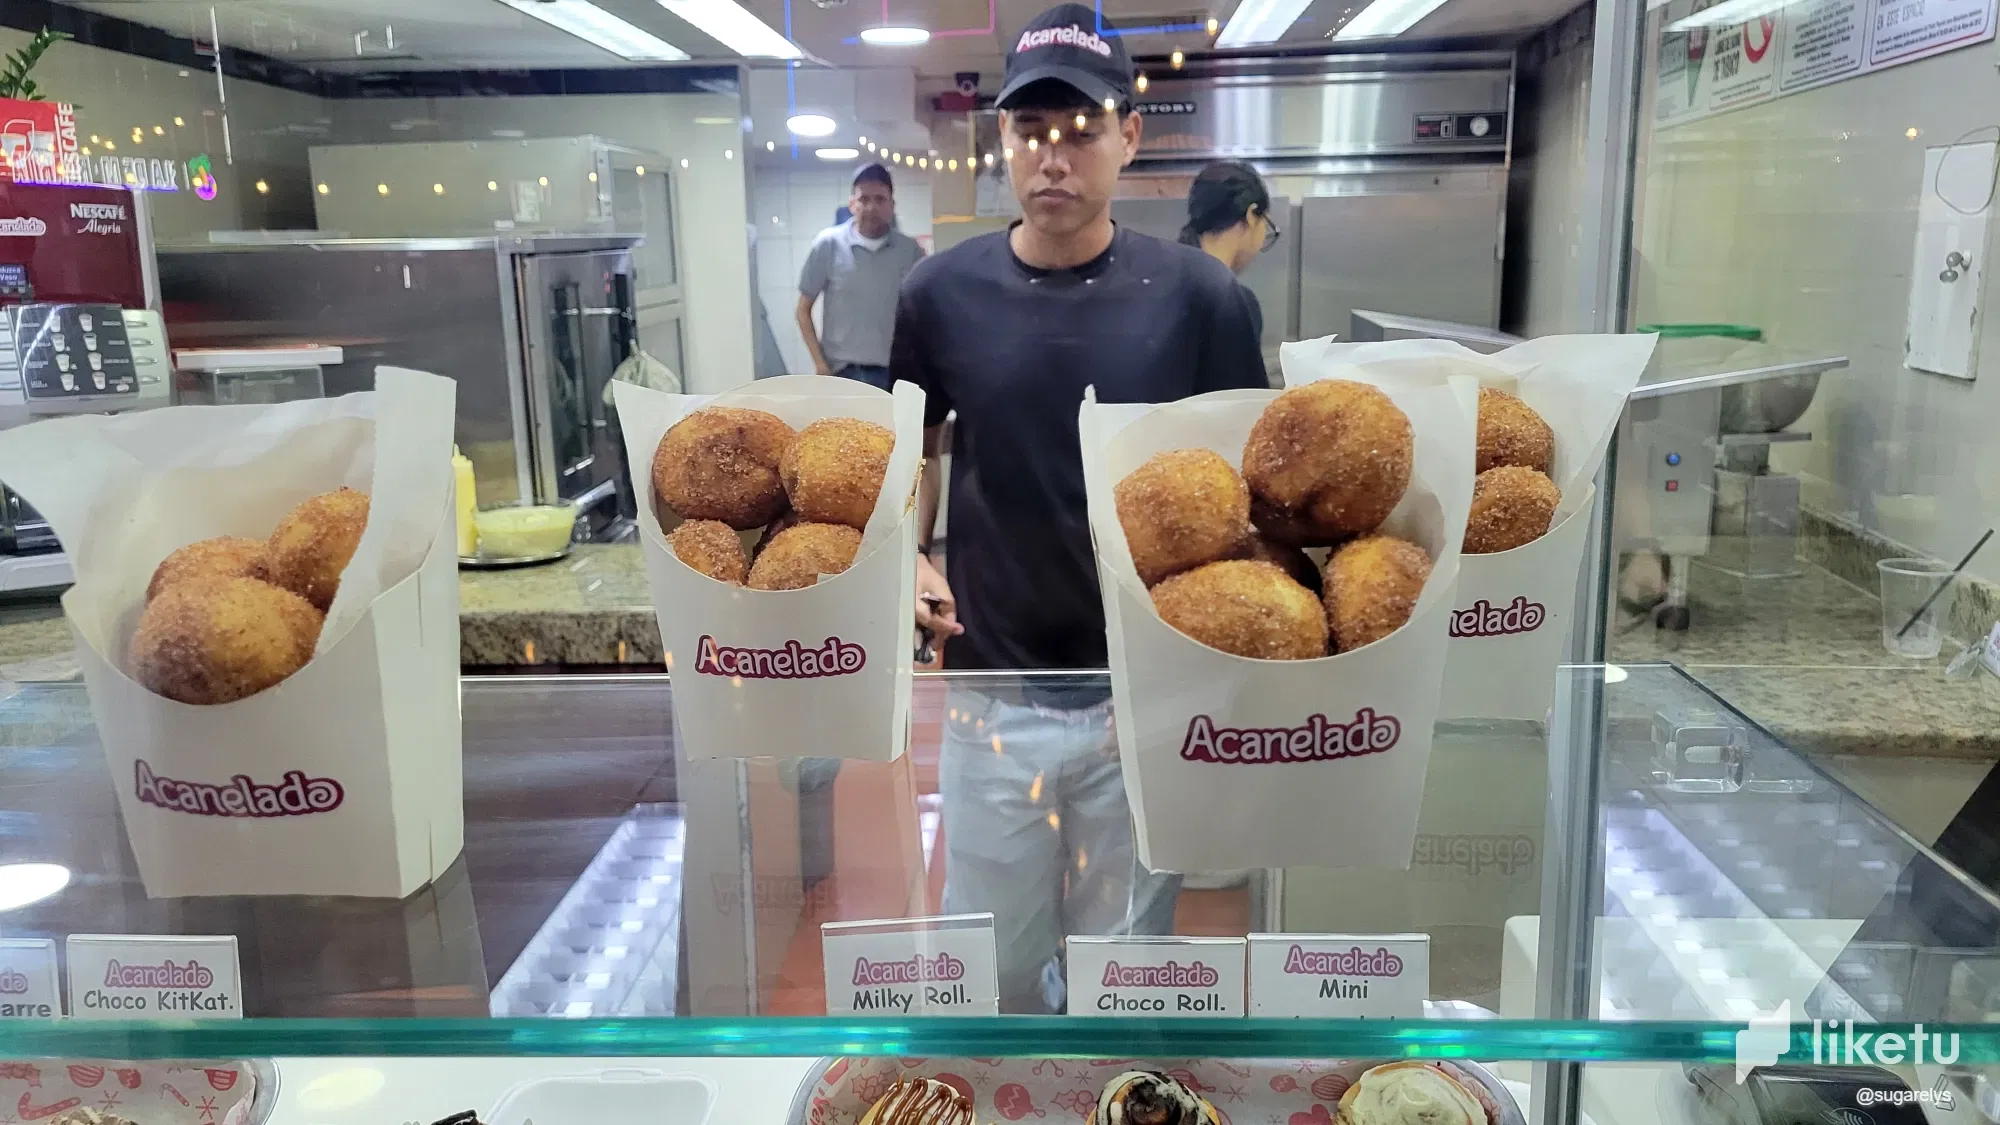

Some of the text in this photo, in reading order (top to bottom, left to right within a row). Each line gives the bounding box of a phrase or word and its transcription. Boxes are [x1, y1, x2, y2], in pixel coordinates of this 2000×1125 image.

[1016, 24, 1112, 57] Acanelado
[695, 635, 866, 679] Acanelado
[1180, 706, 1401, 765] Acanelado
[134, 758, 345, 818] Acanelado
[104, 958, 213, 989] Acanelado
[852, 952, 965, 986] Acanelado
[1101, 960, 1218, 988] Acanelado
[1284, 944, 1403, 977] Acanelado
[84, 990, 234, 1011] Choco KitKat.
[852, 983, 972, 1014] Milky Roll.
[1096, 993, 1226, 1012] Choco Roll.
[1319, 978, 1368, 999] Mini
